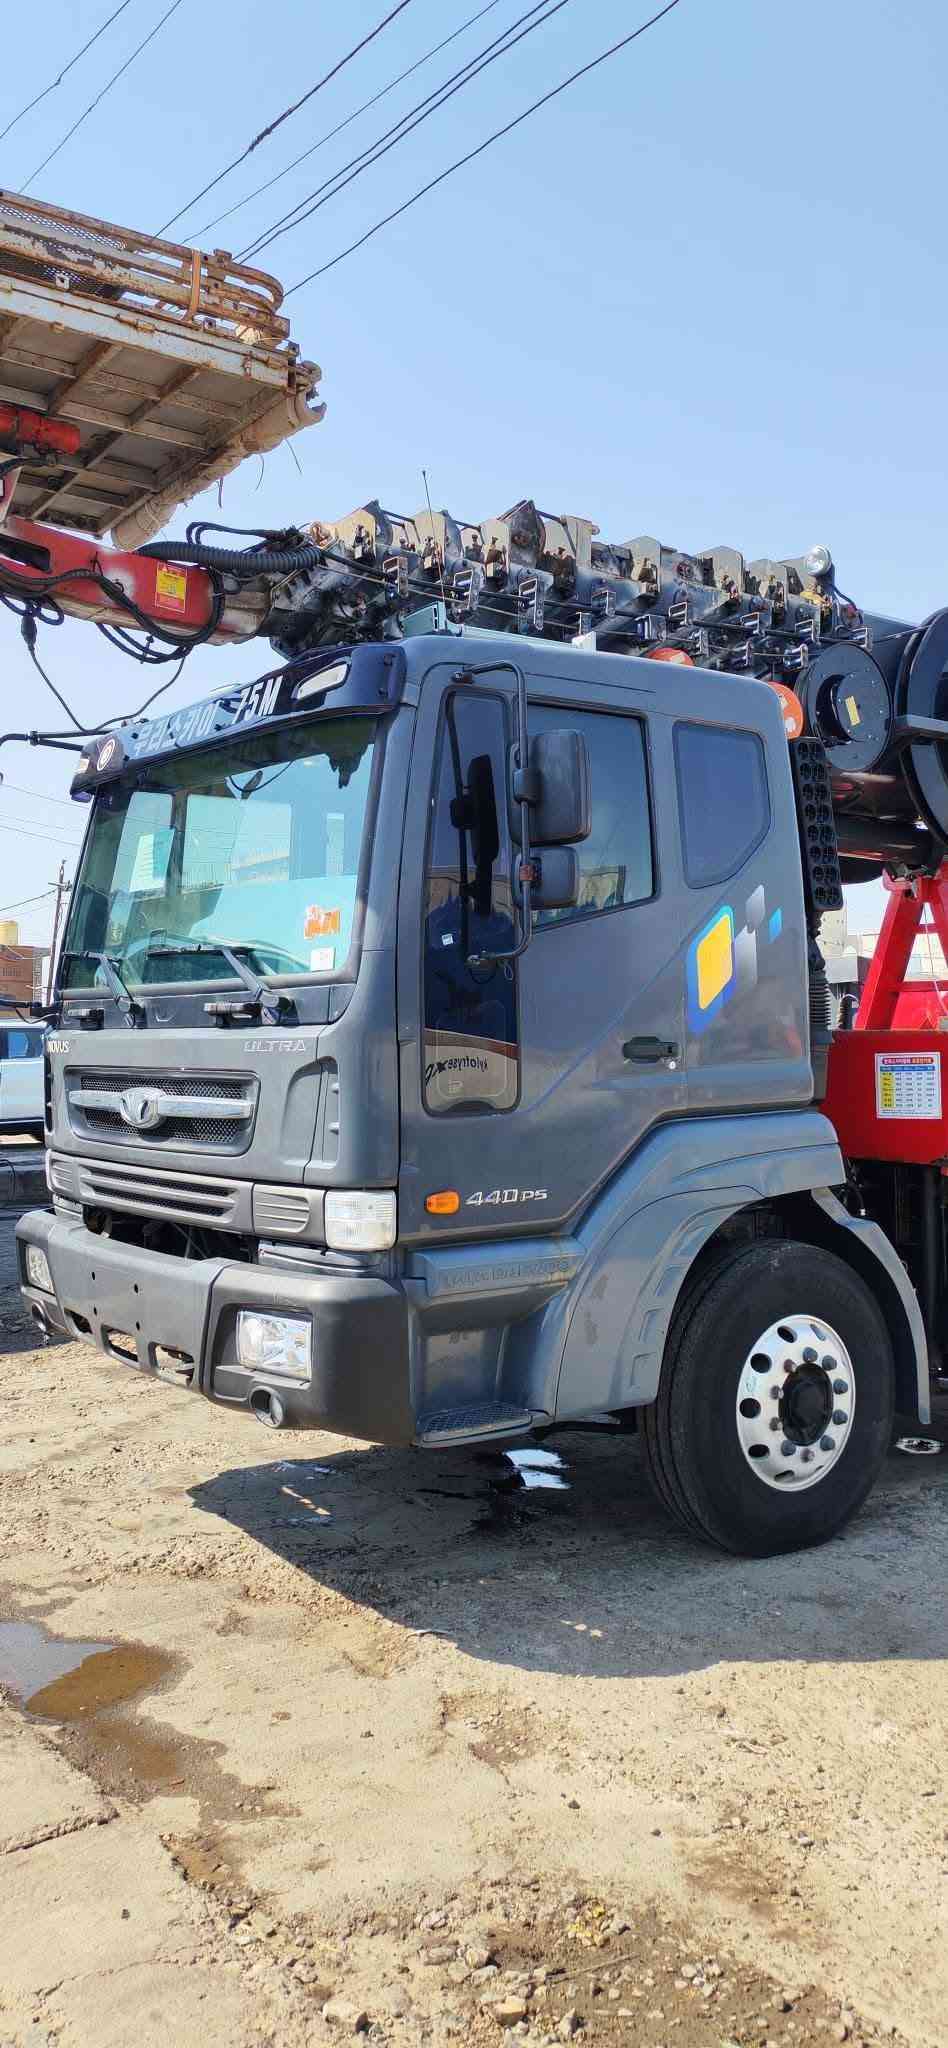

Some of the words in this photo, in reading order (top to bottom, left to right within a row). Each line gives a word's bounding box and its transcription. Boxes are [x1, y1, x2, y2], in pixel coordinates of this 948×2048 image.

[232, 675, 284, 725] 75M
[47, 1040, 70, 1053] NOVUS
[244, 1039, 307, 1053] ULTRA
